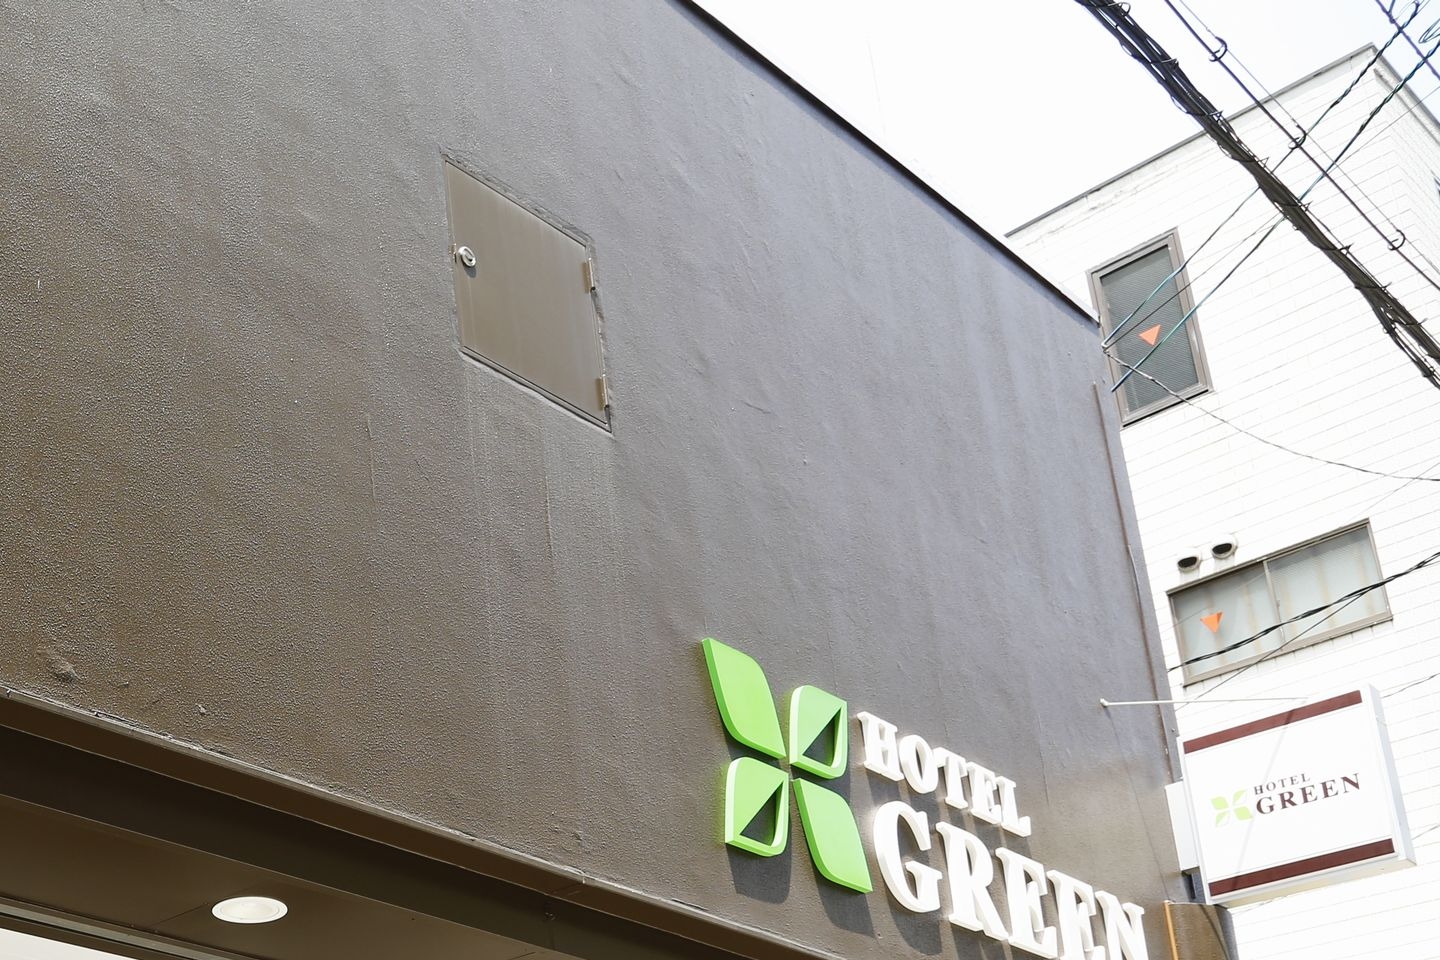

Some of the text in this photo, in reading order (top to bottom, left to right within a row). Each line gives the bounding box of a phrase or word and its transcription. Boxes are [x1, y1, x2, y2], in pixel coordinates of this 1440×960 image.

[857, 711, 1031, 838] HOTEL
[1253, 773, 1310, 796] HOTEL
[1256, 773, 1361, 816] GREEN
